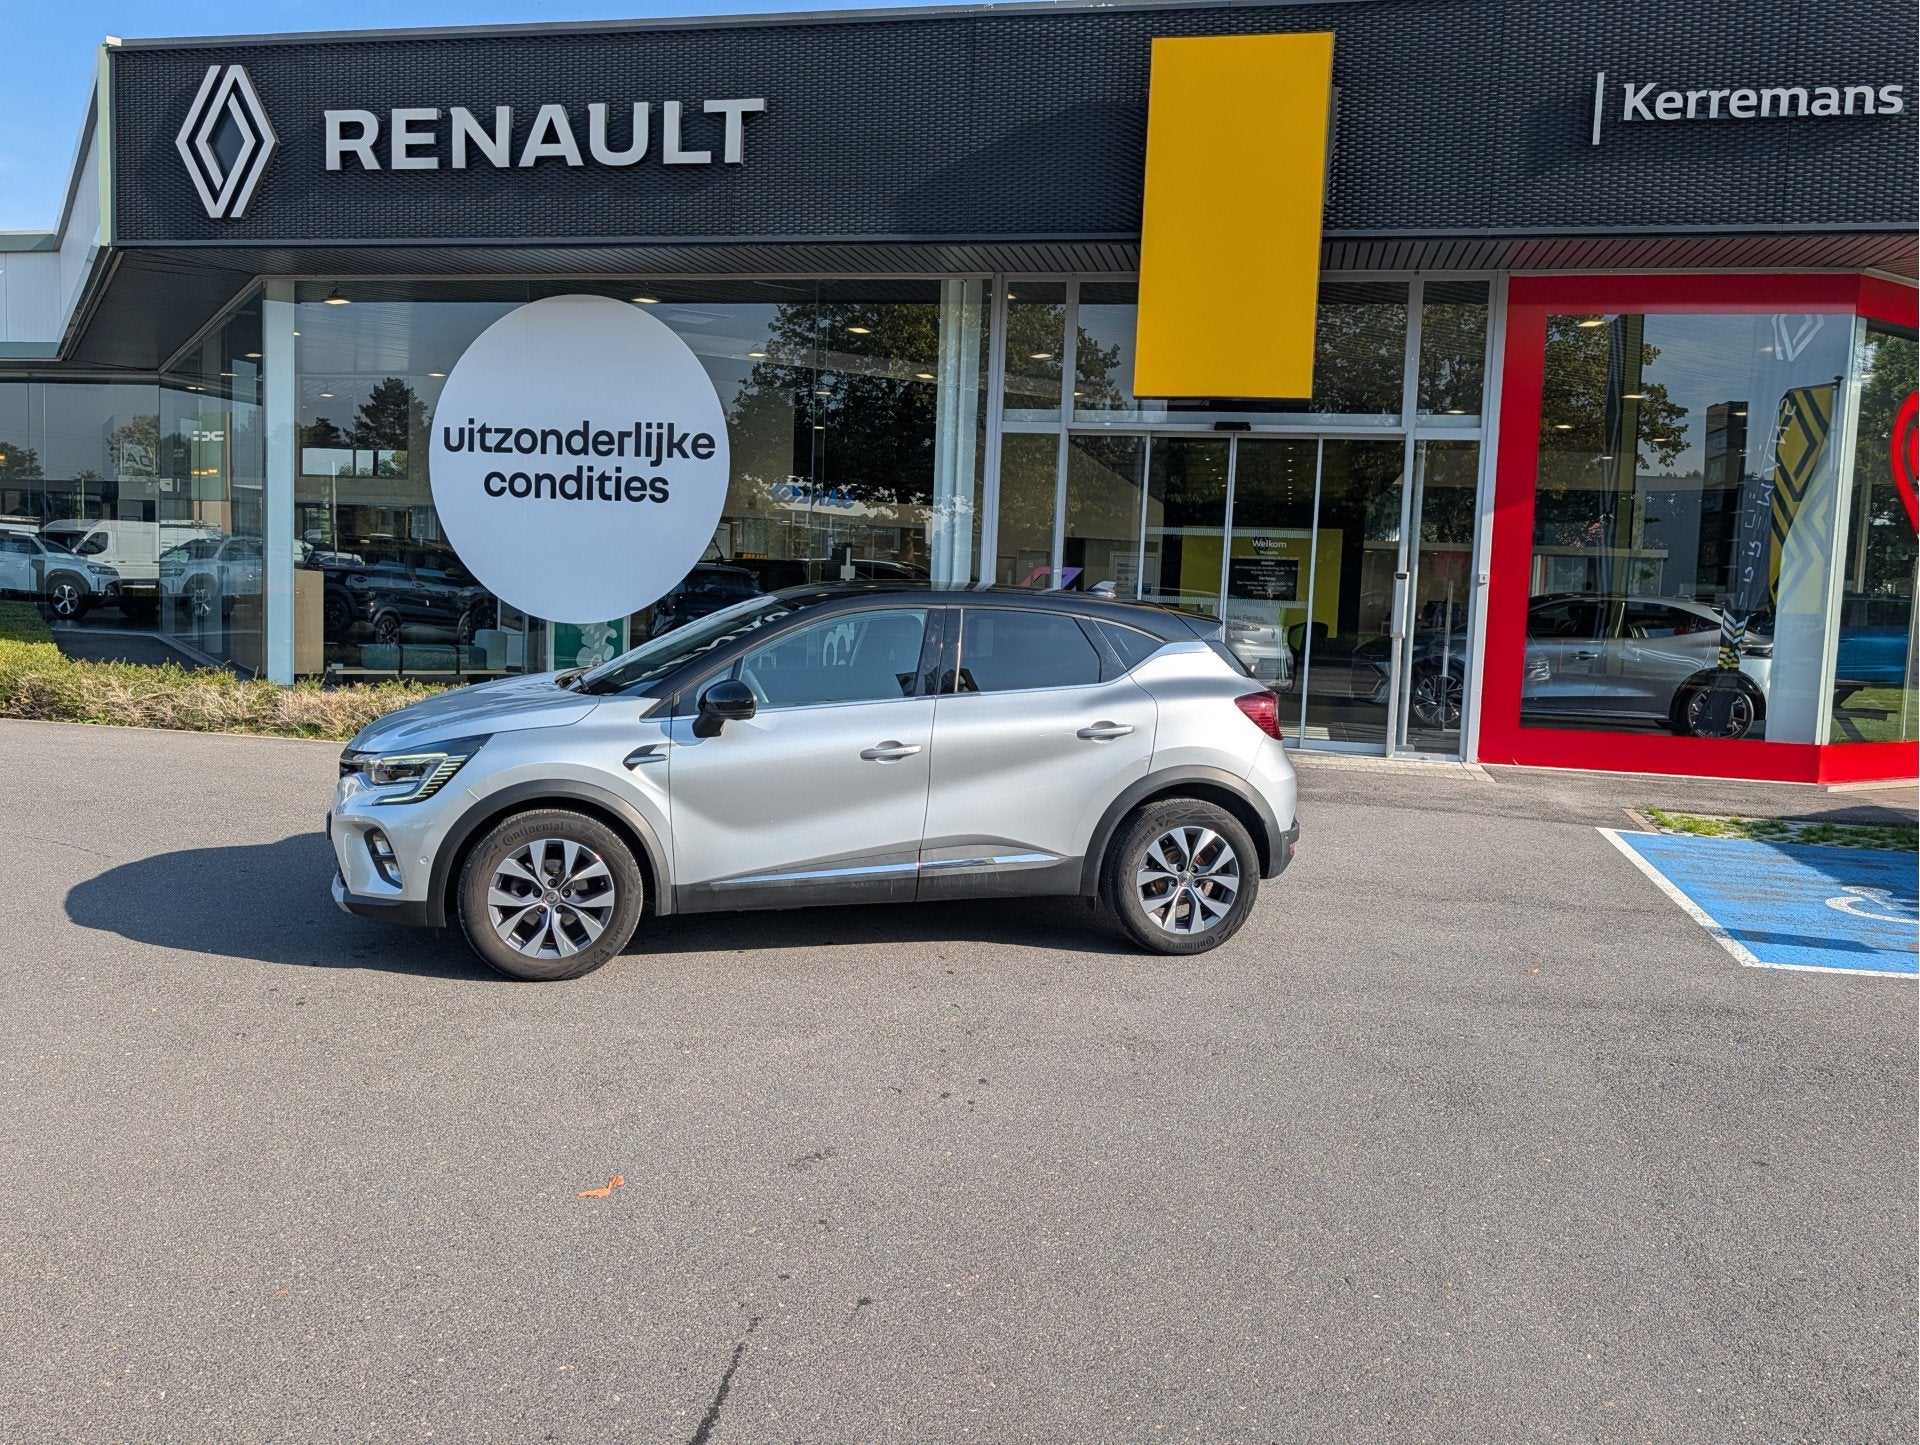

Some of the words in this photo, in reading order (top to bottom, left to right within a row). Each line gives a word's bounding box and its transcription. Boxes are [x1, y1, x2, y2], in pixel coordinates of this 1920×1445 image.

[1623, 82, 1905, 121] Kerremans
[323, 98, 767, 171] RENAULT
[443, 417, 716, 467] uitzonderlijke
[483, 465, 670, 504] condities
[1252, 539, 1287, 548] Welkom
[502, 822, 564, 846] Continental
